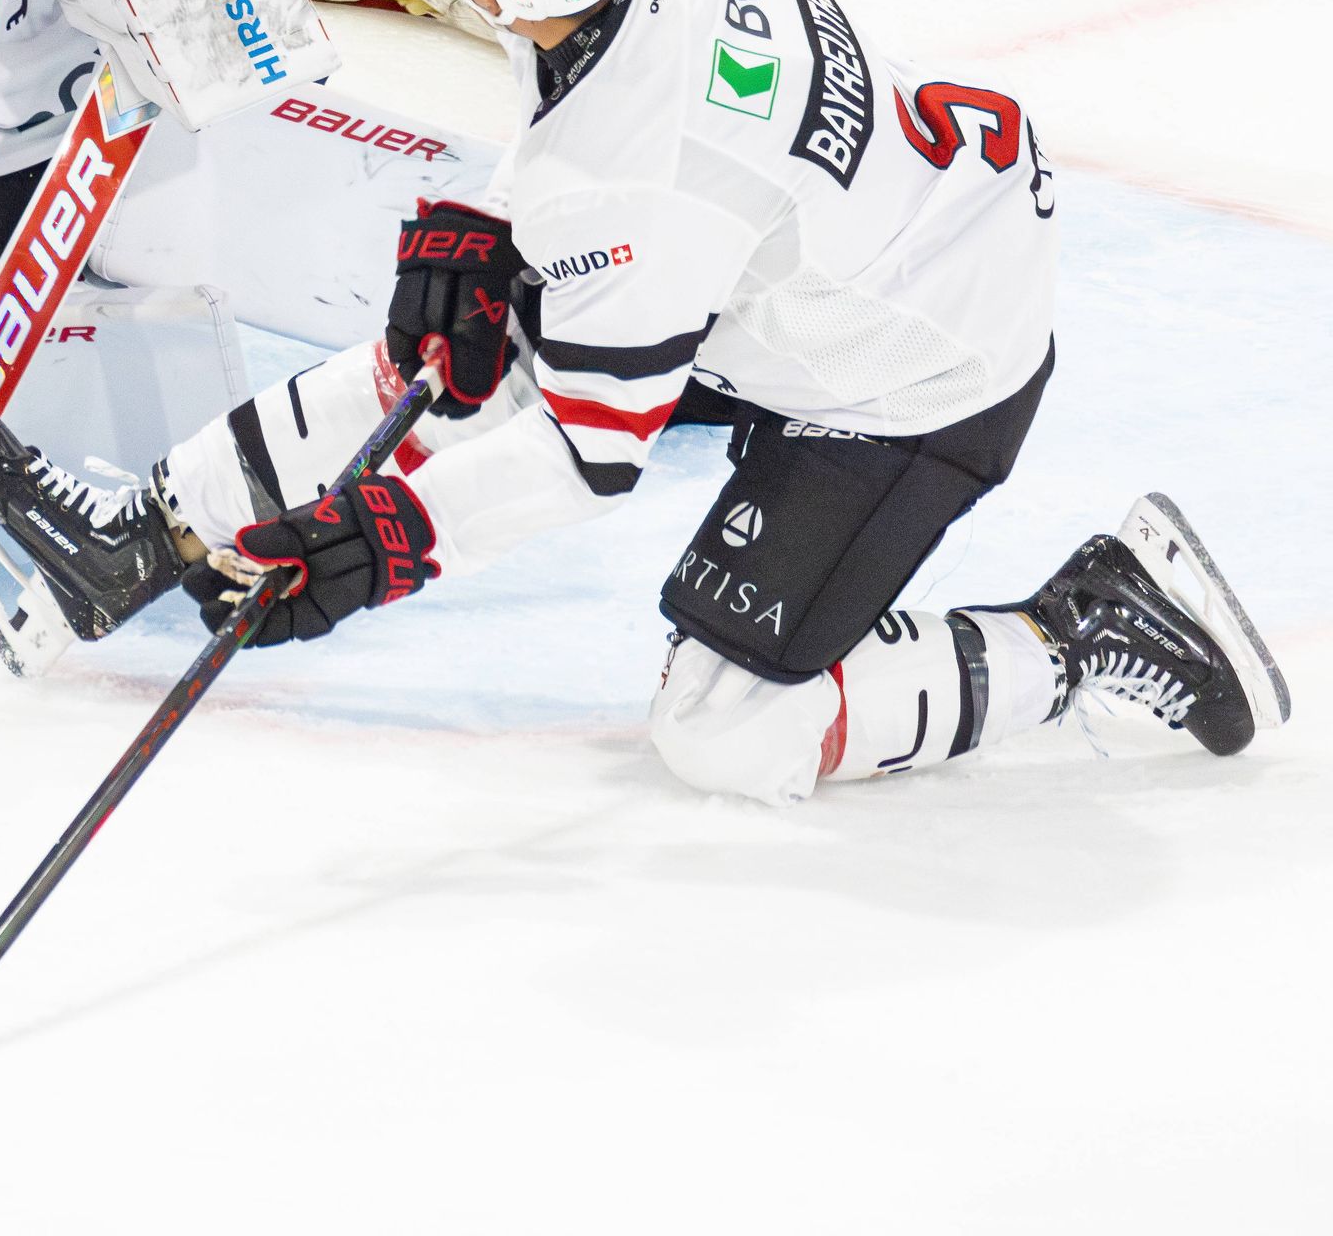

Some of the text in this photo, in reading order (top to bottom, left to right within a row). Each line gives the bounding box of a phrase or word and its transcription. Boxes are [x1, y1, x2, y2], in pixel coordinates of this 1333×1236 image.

[270, 98, 448, 162] BAUER
[893, 81, 1021, 174] 5
[396, 229, 498, 262] UER
[542, 250, 611, 281] VAUD
[26, 509, 79, 555] BAUER
[358, 484, 415, 605] BAU
[674, 550, 783, 636] RTISA
